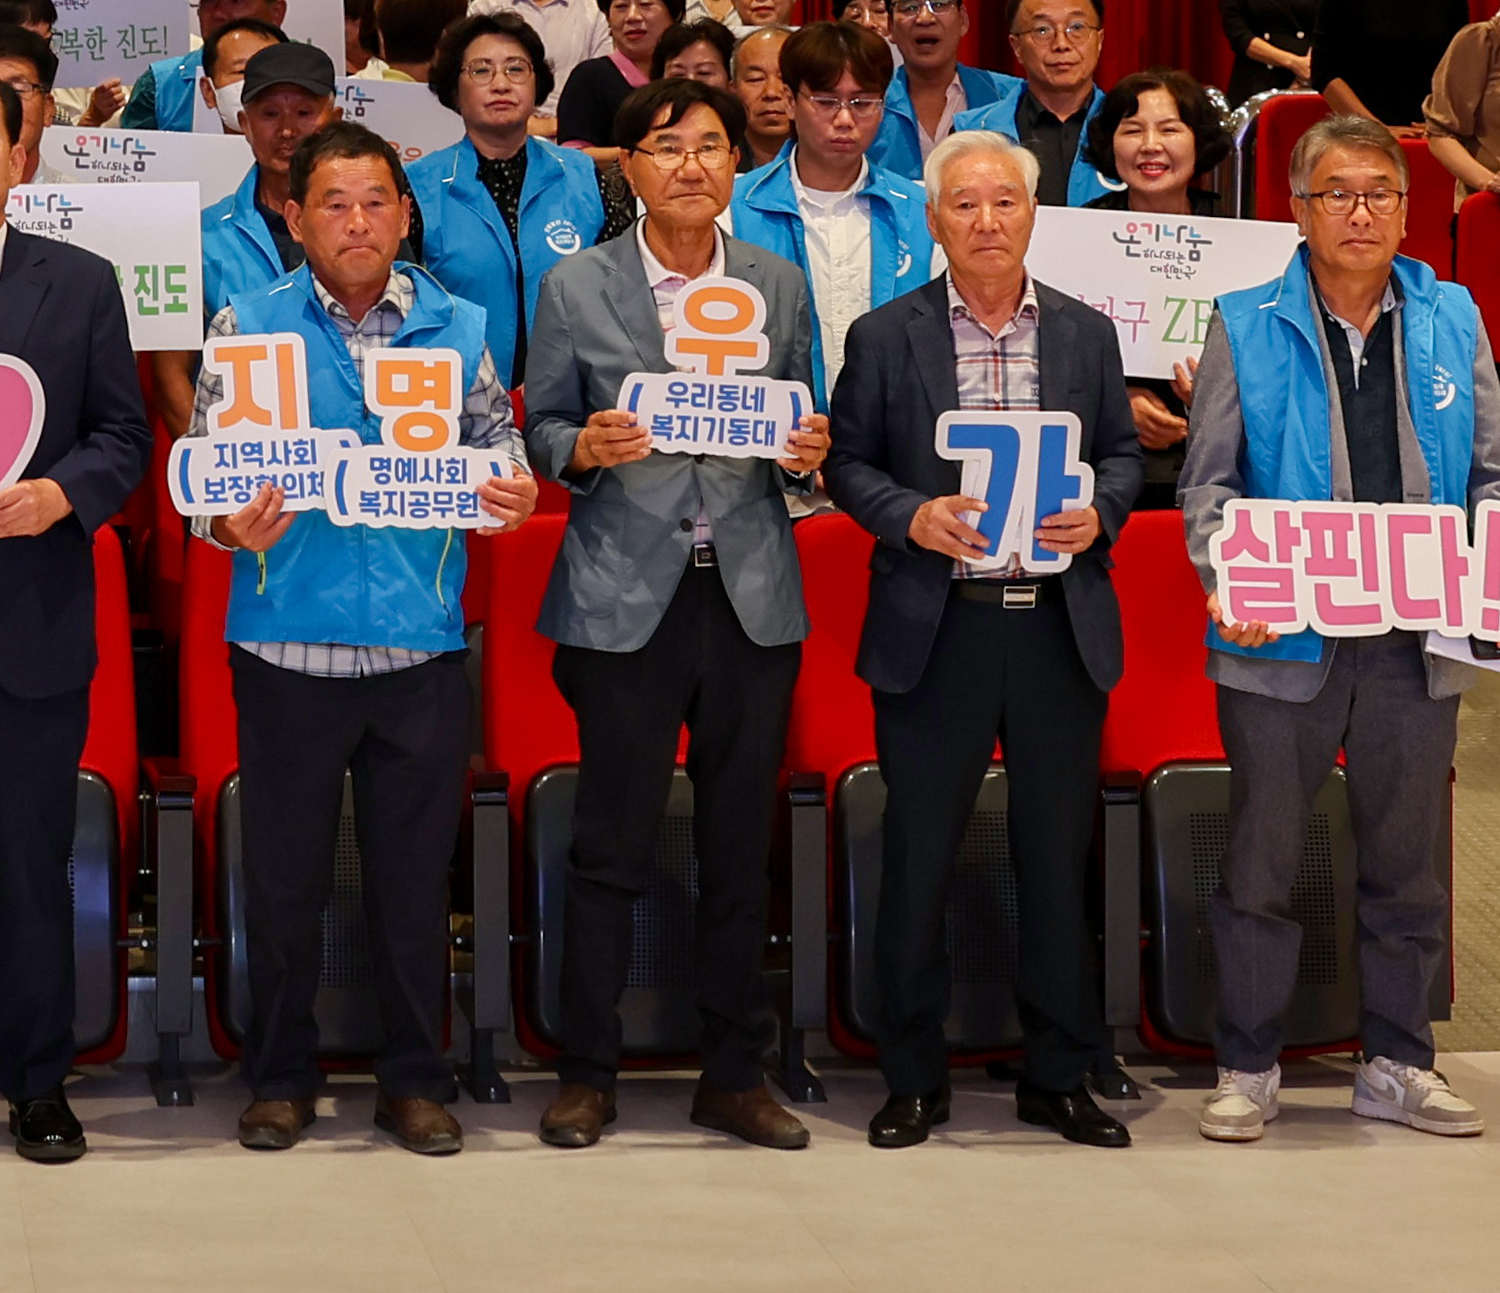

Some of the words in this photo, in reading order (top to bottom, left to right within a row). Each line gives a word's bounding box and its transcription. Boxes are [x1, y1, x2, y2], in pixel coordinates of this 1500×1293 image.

[117, 24, 169, 60] 진도!
[63, 135, 157, 172] 온기나눔
[1113, 222, 1212, 262] 온기나눔
[134, 264, 188, 316] 진도
[675, 286, 758, 376] 우
[213, 343, 299, 430] 지
[665, 381, 766, 413] 우리동네
[376, 360, 451, 452] 명
[651, 414, 776, 447] 복지기동대
[213, 439, 318, 470] 지역사회
[369, 458, 468, 485] 명예사회
[947, 424, 1081, 563] 가
